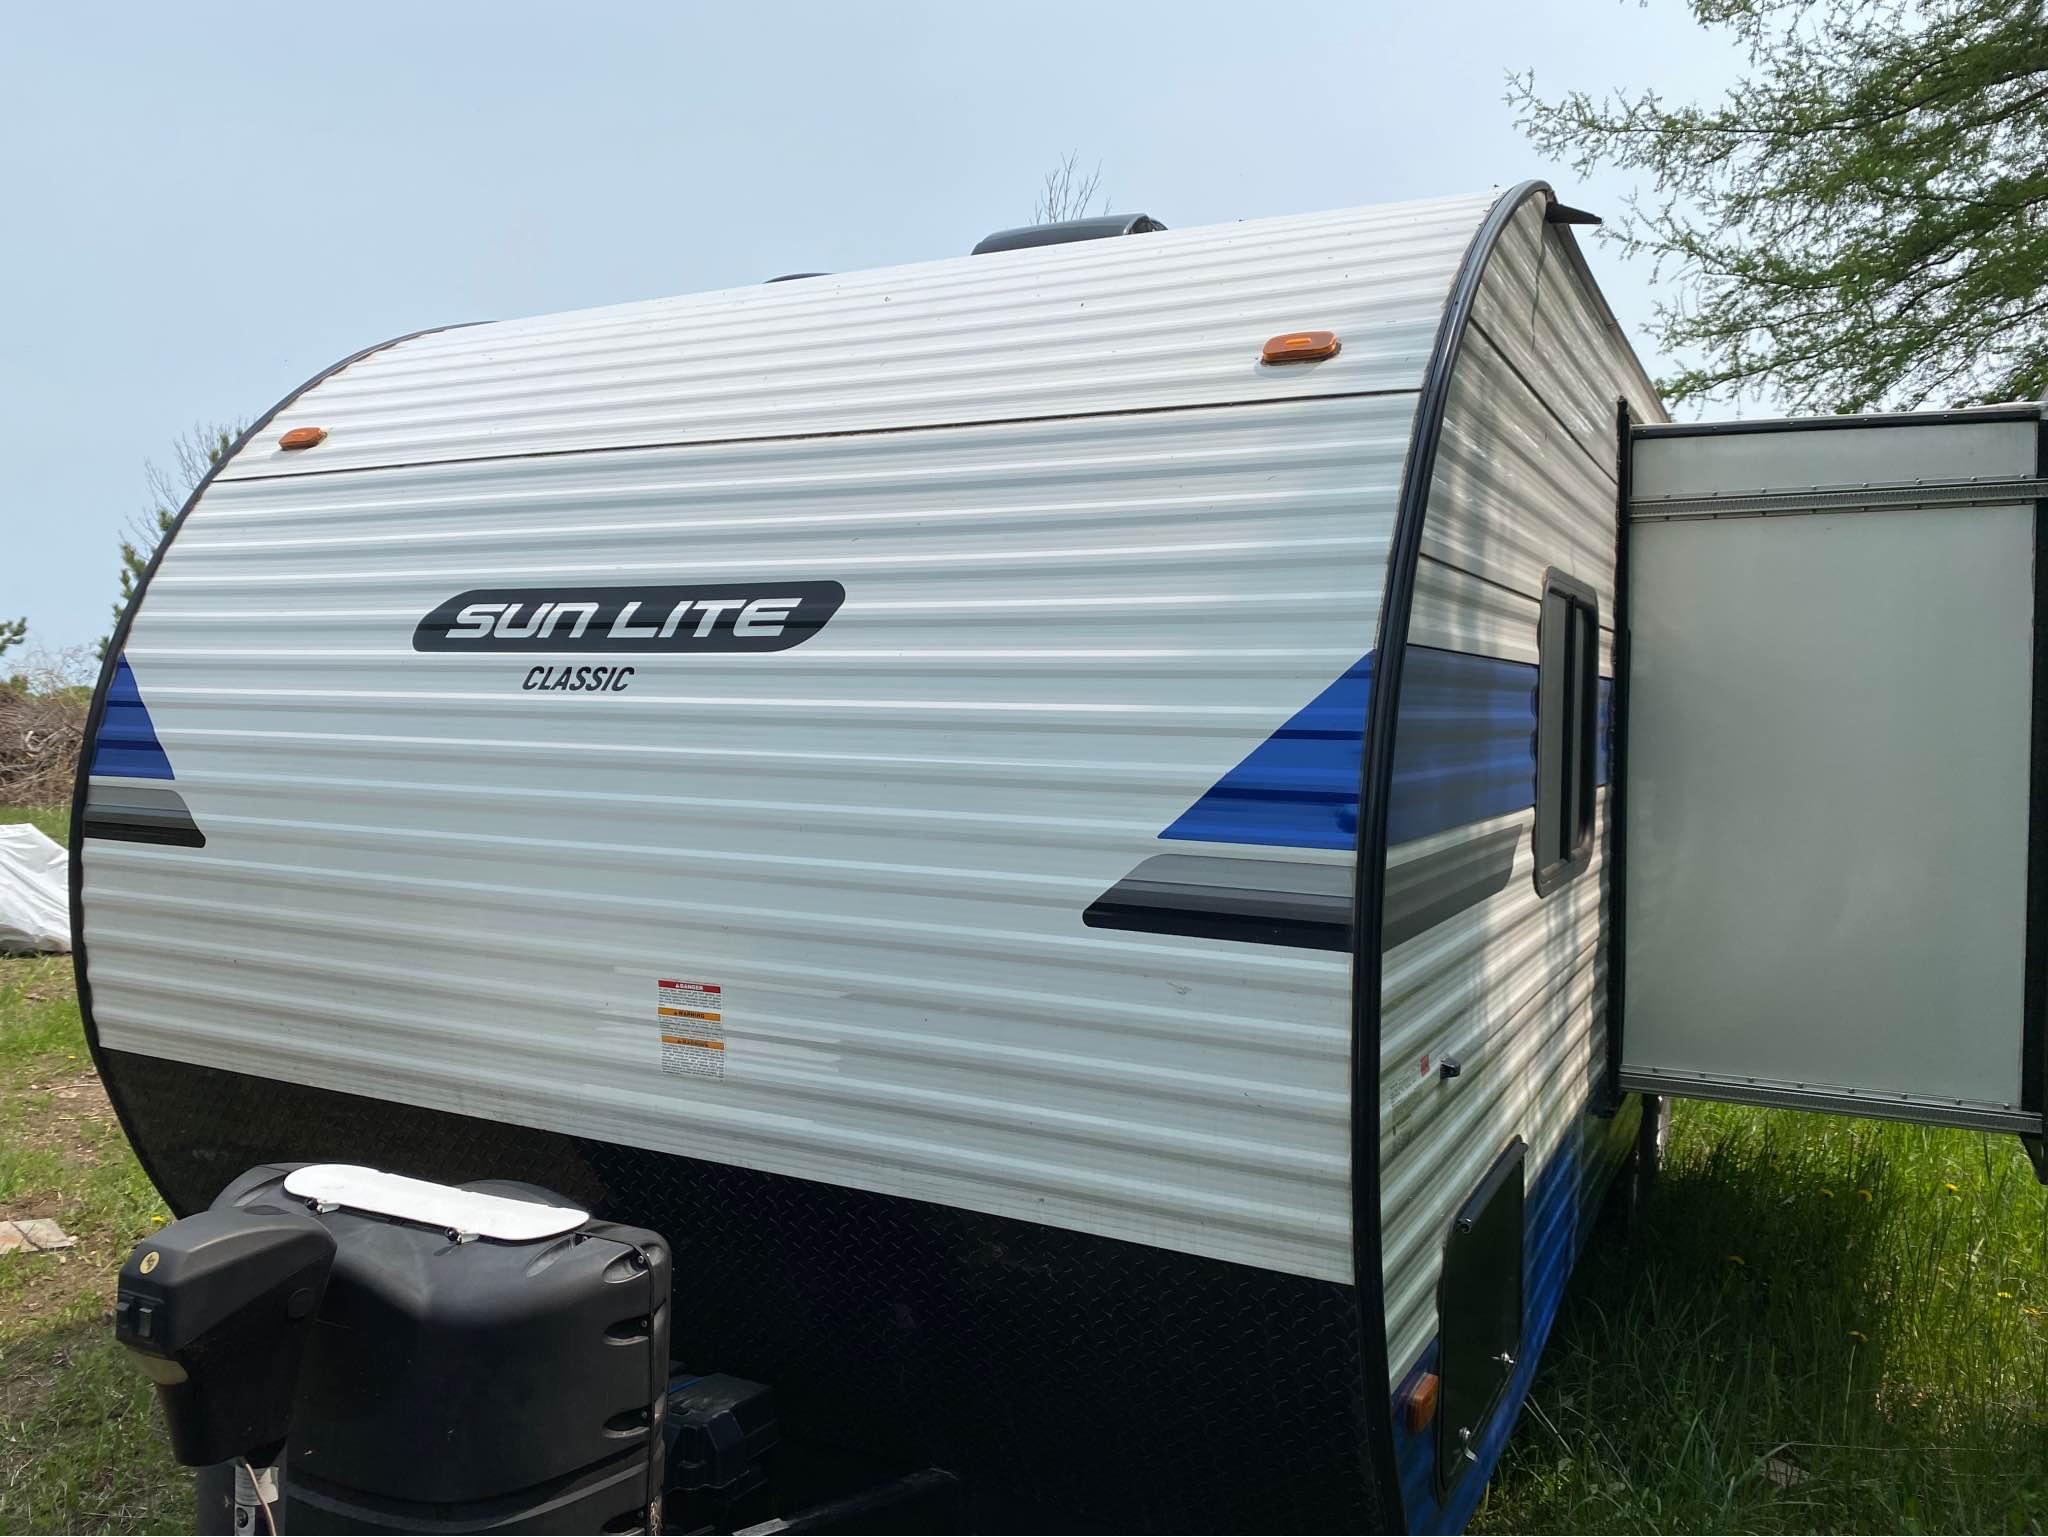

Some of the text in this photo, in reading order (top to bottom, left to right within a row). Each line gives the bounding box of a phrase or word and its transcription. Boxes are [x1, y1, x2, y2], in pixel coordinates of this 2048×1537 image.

[445, 597, 802, 639] SUN LITE
[522, 666, 635, 692] CLASSIC
